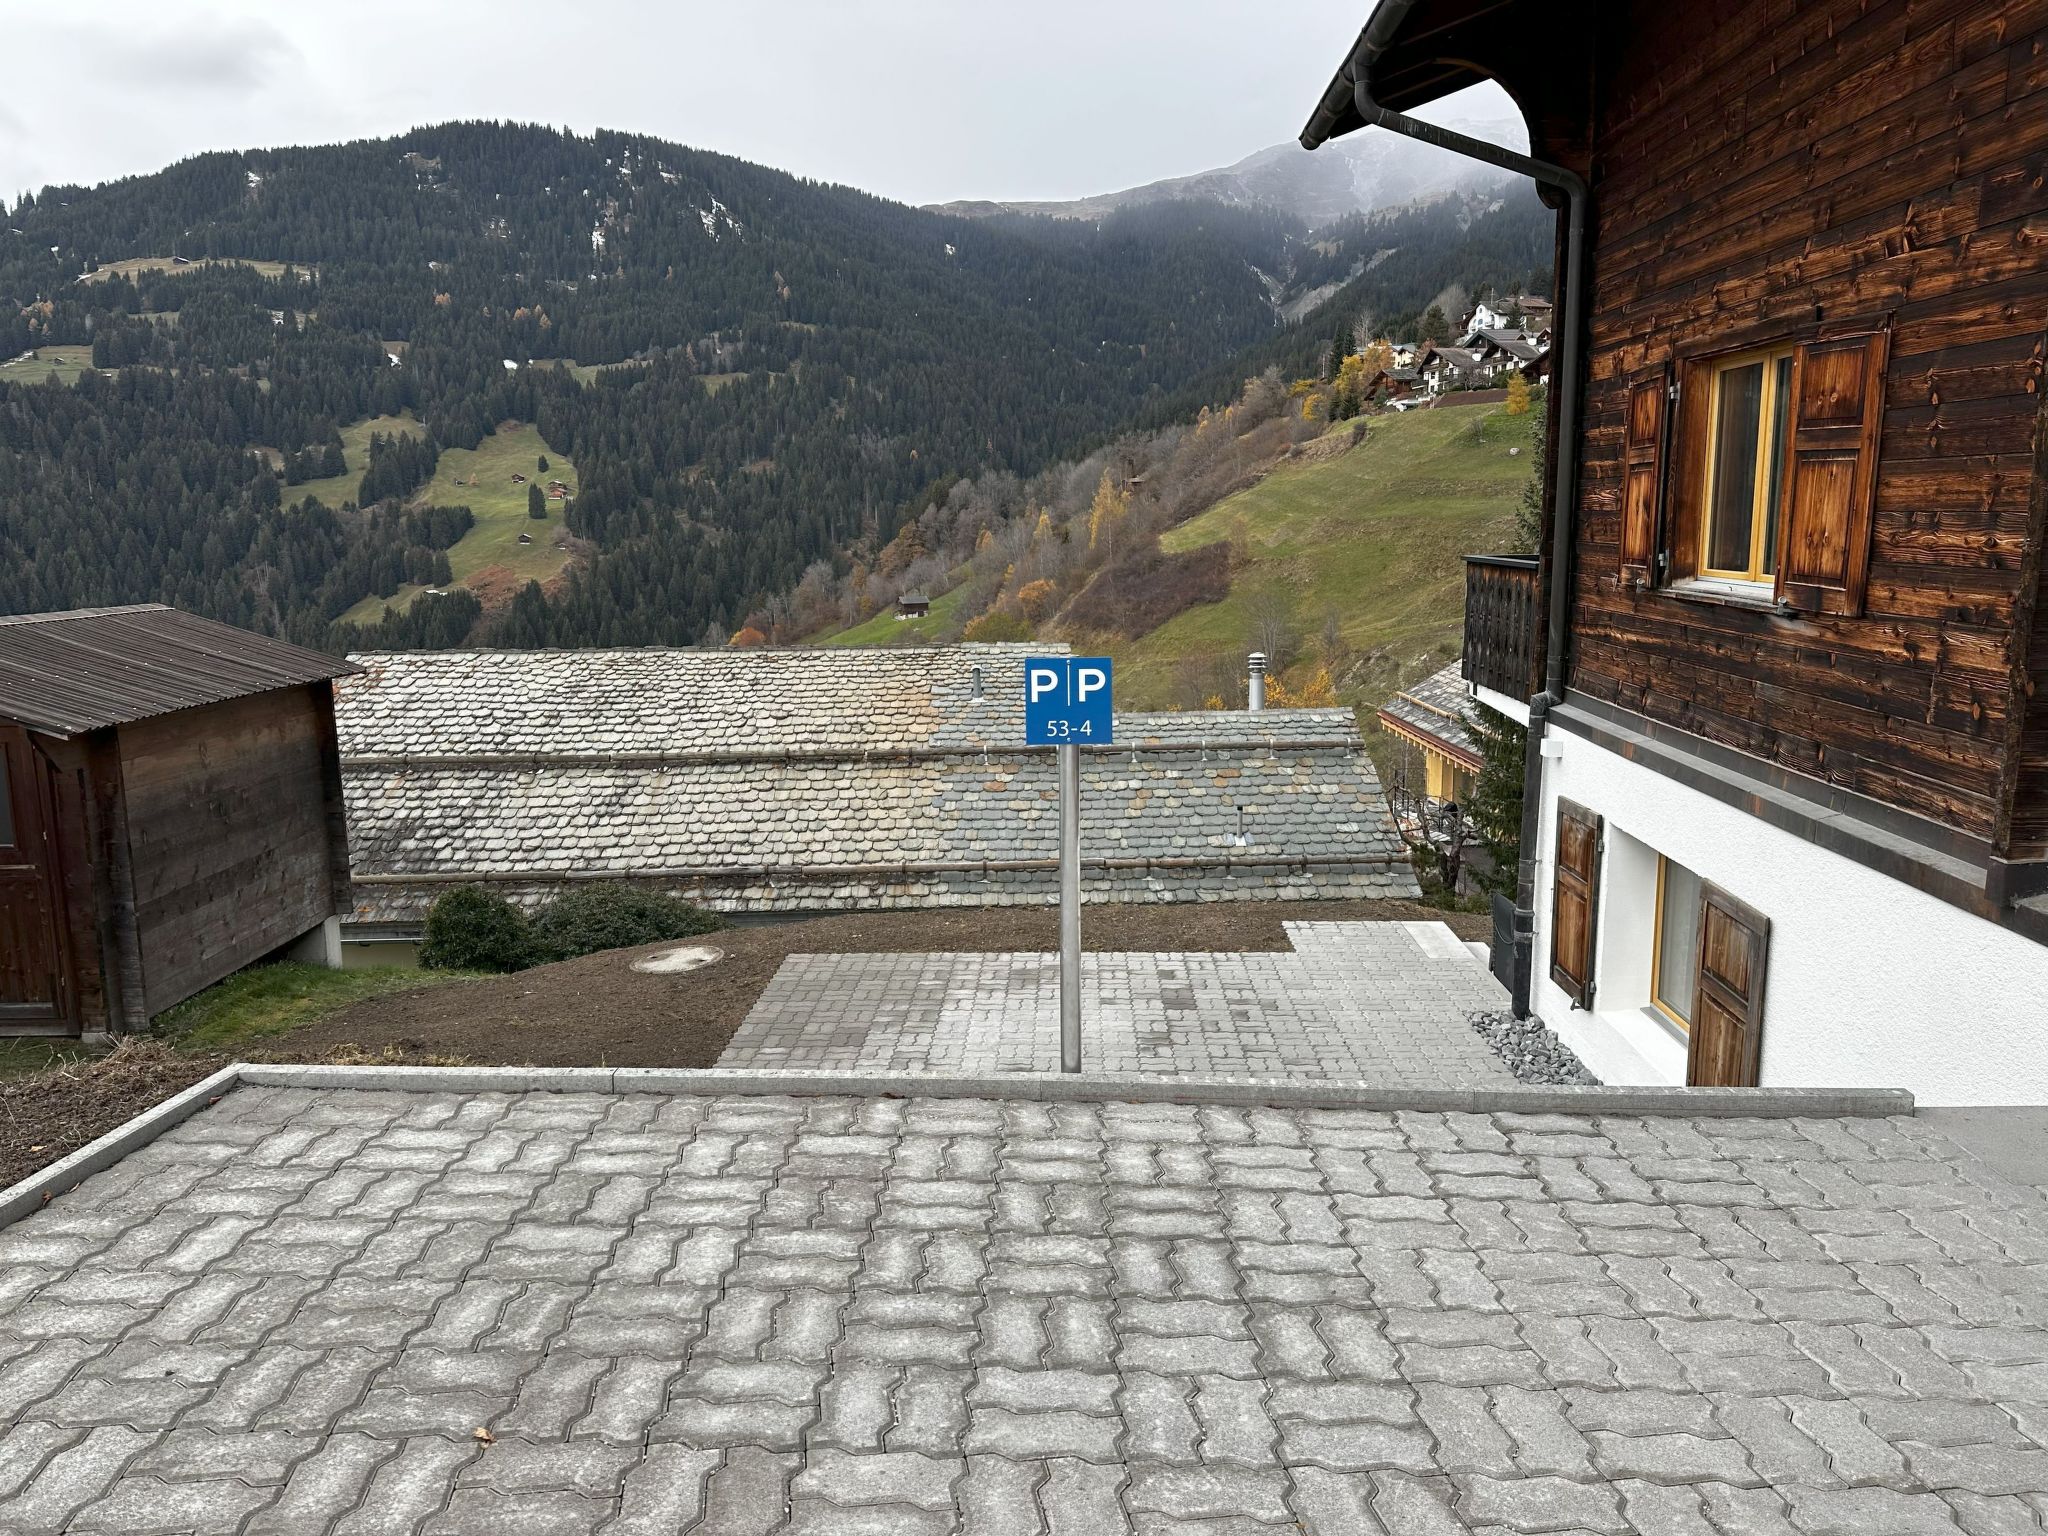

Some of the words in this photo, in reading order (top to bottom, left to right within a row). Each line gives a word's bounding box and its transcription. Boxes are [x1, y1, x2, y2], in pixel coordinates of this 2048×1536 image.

[1030, 669, 1058, 703] P
[1078, 668, 1106, 702] P
[1046, 719, 1092, 737] 53-4
